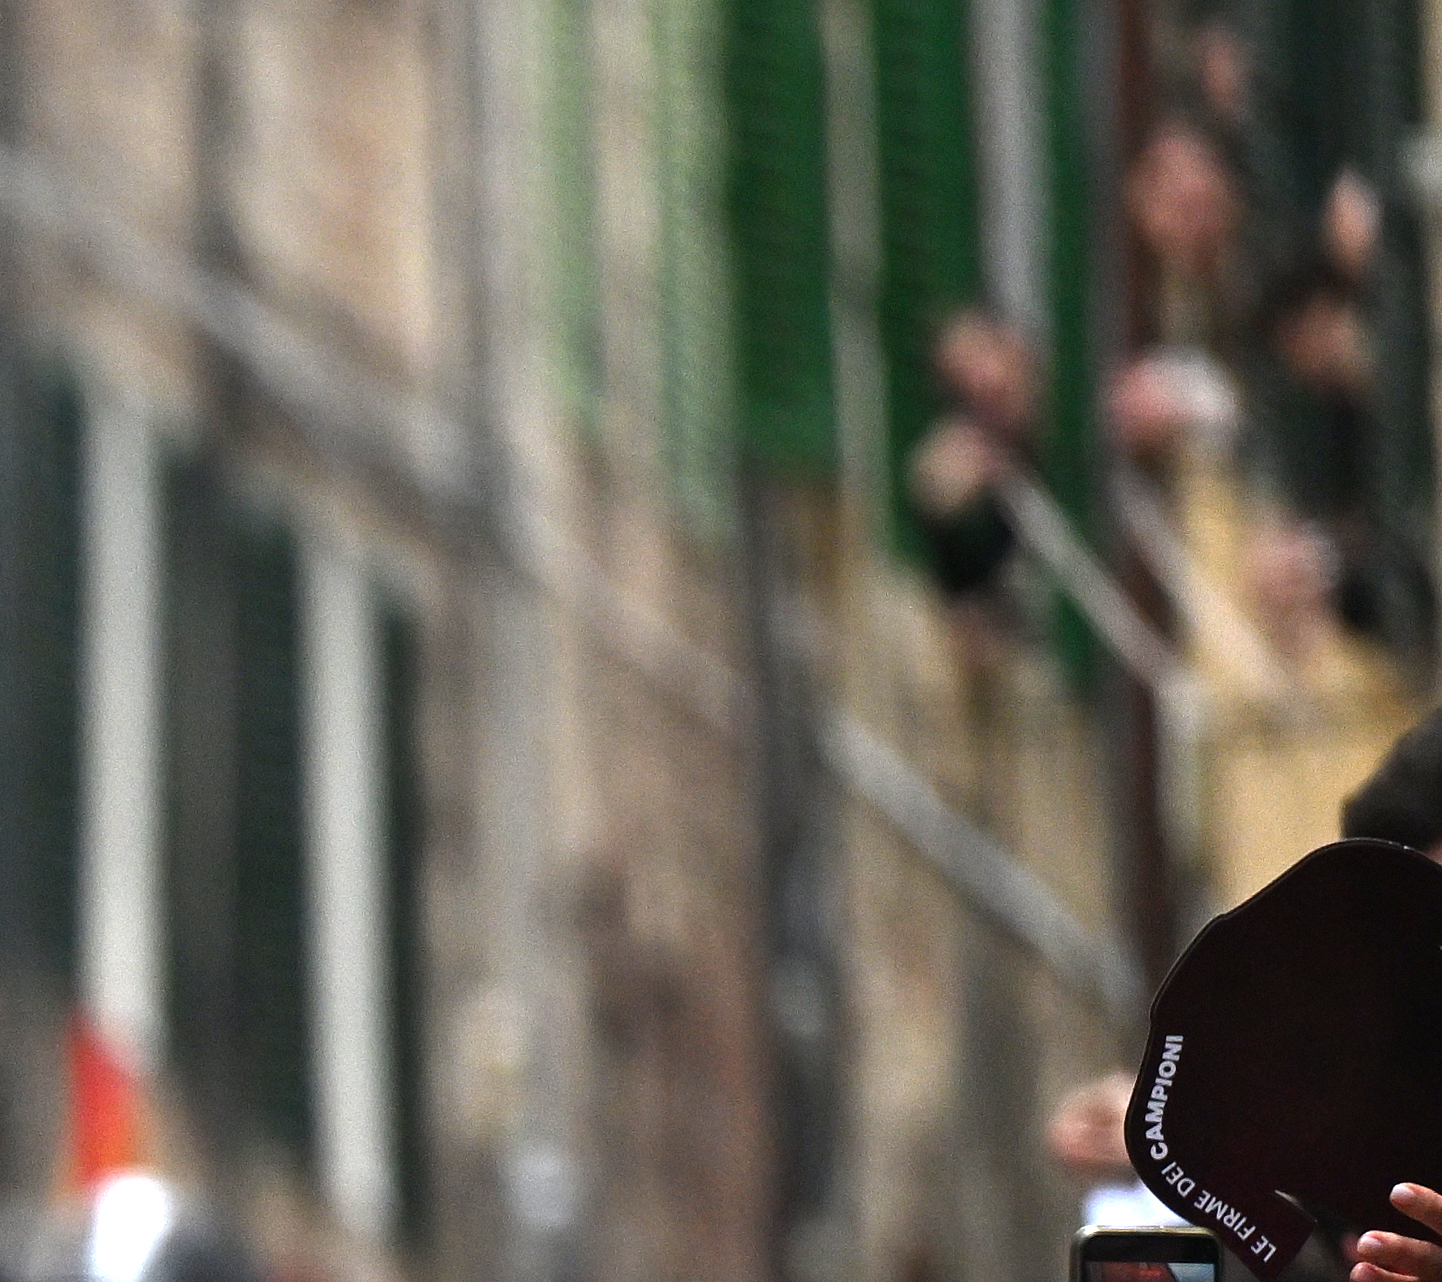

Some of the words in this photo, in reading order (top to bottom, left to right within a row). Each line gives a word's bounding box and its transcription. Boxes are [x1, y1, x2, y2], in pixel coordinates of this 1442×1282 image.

[1145, 1034, 1184, 1160] CAMPIONI
[1161, 1161, 1196, 1198] DEI
[1194, 1190, 1256, 1241] FIRME
[1251, 1235, 1277, 1263] LE
